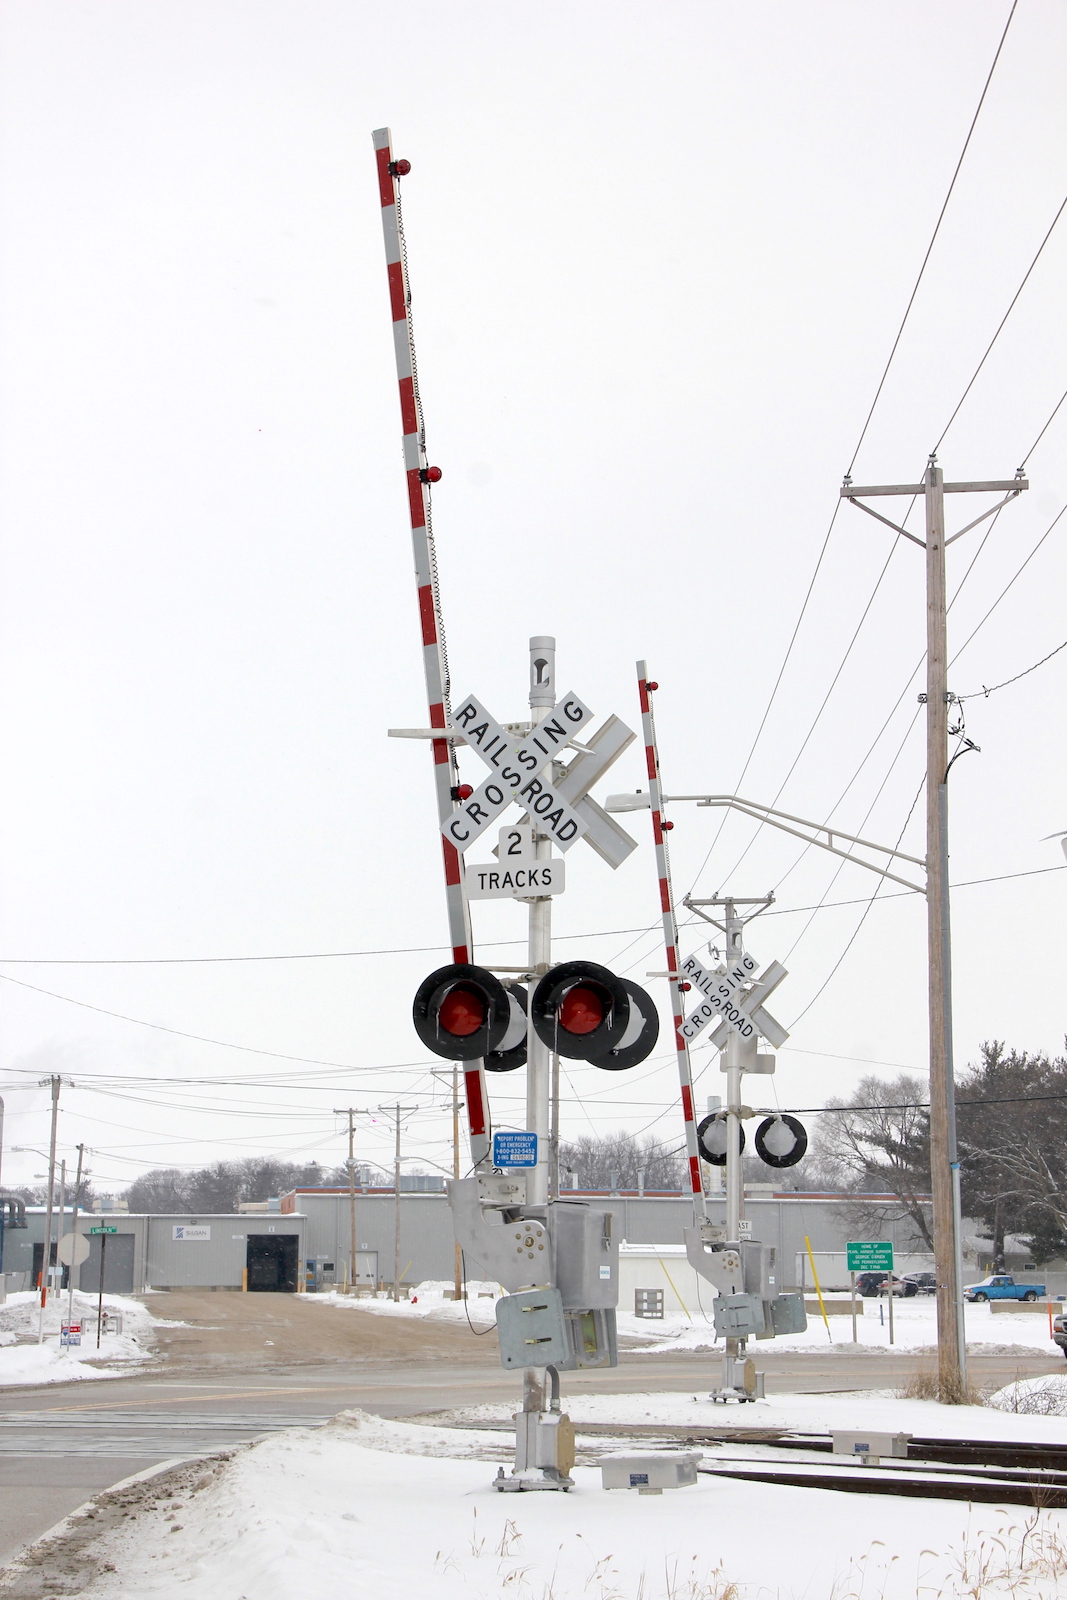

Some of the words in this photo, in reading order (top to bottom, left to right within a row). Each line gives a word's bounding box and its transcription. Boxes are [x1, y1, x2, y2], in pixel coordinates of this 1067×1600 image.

[450, 701, 584, 842] CROSSING
[507, 832, 522, 855] 2
[477, 868, 552, 890] TRACKS
[682, 957, 754, 1038] CROSSING
